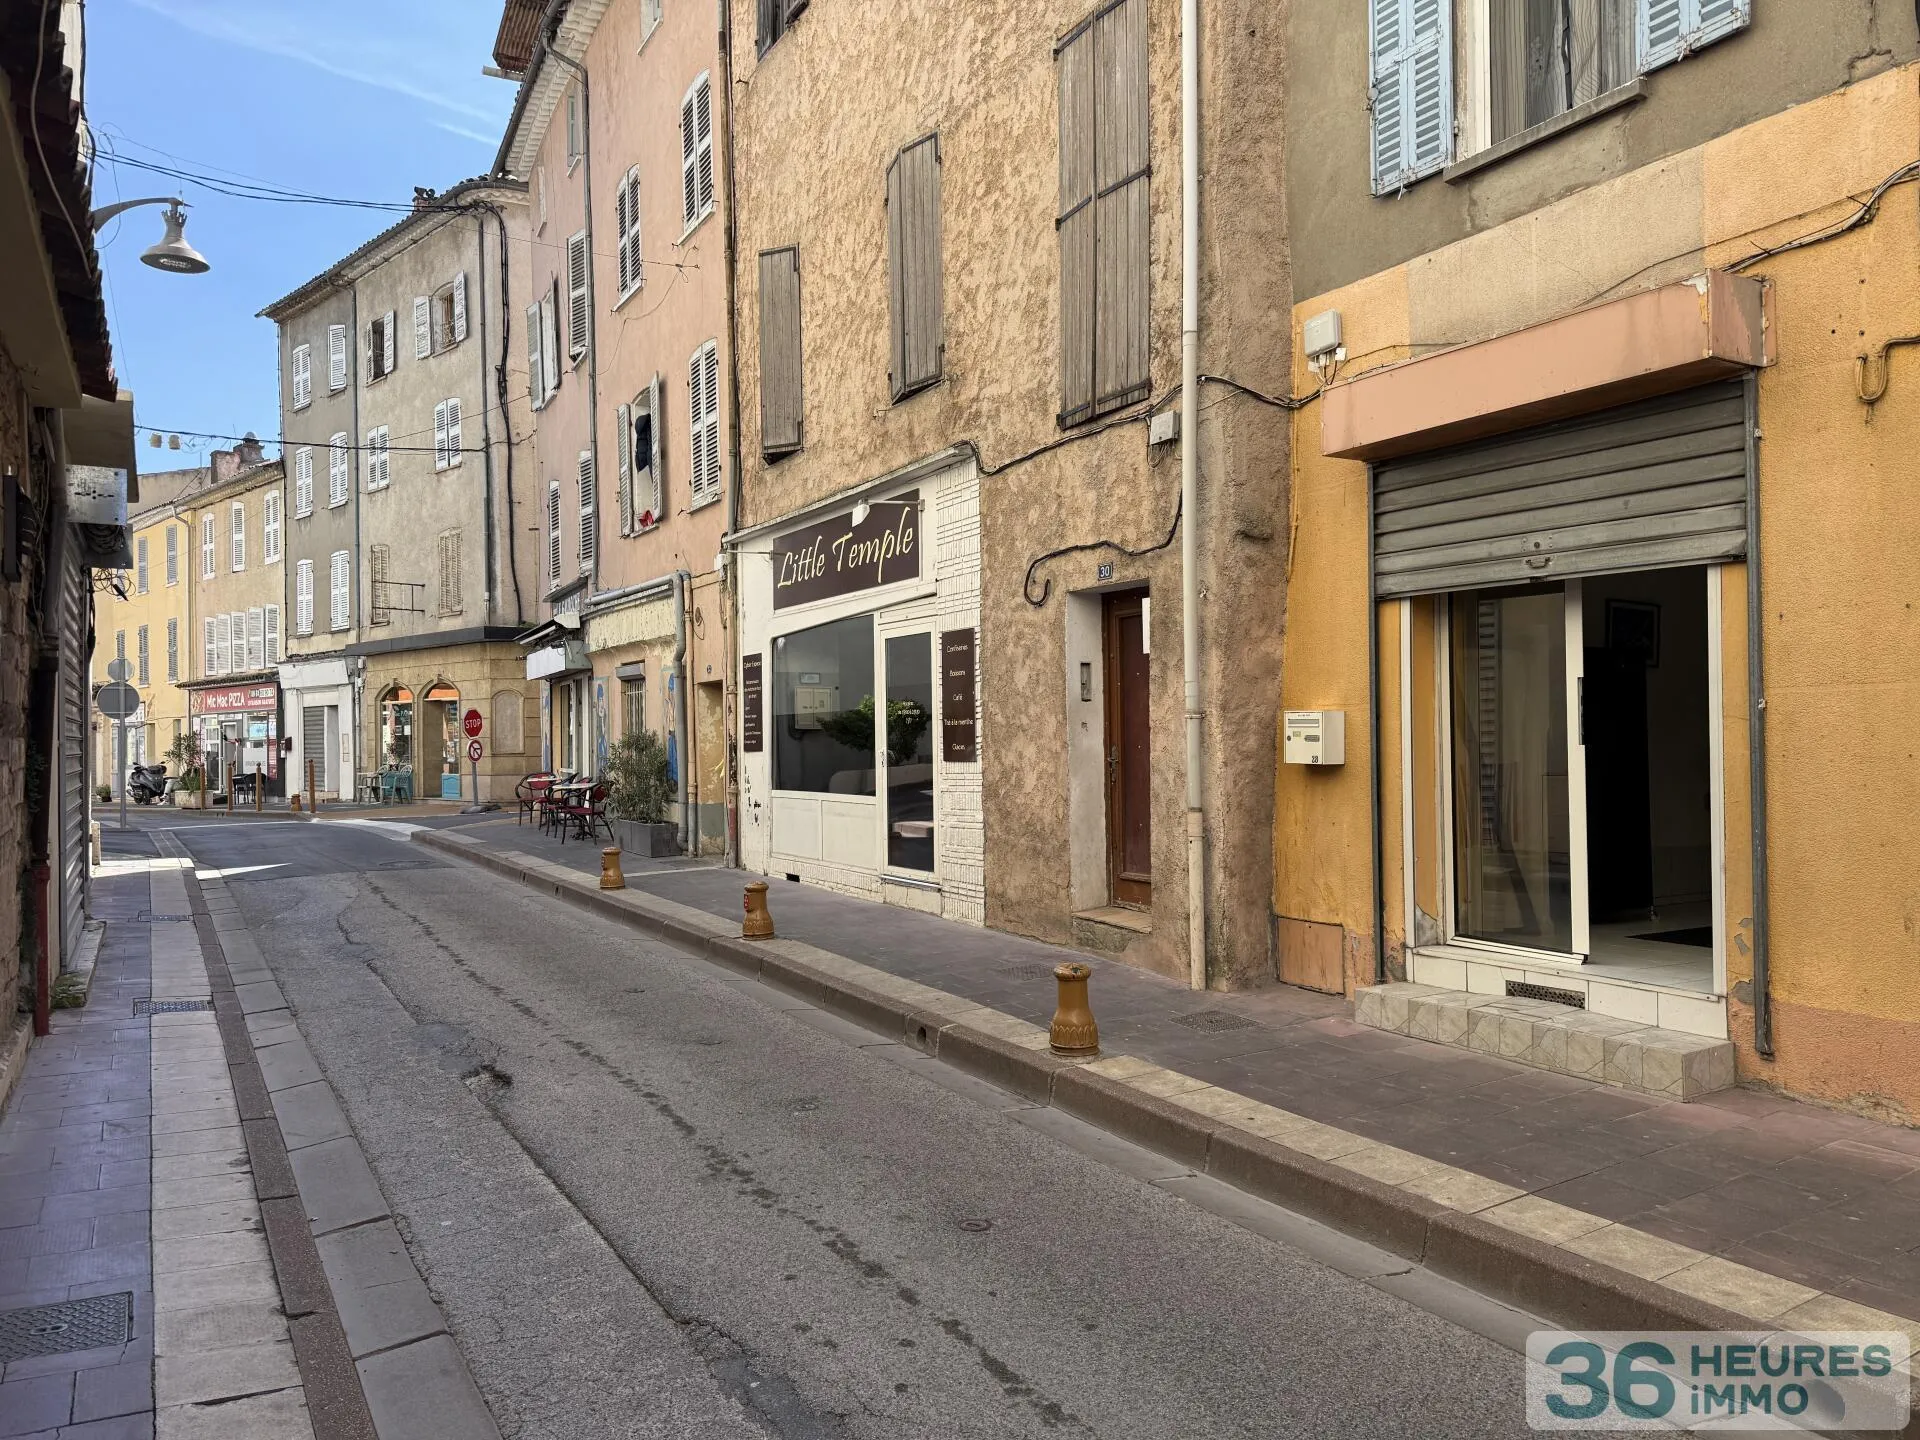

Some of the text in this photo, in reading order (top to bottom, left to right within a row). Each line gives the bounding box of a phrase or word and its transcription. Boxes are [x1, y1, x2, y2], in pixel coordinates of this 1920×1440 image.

[777, 506, 914, 589] Little Temple
[1100, 565, 1110, 578] 30
[206, 694, 217, 708] Mic
[217, 693, 228, 708] Mac
[228, 691, 245, 707] PIZZA
[465, 719, 481, 729] STOP
